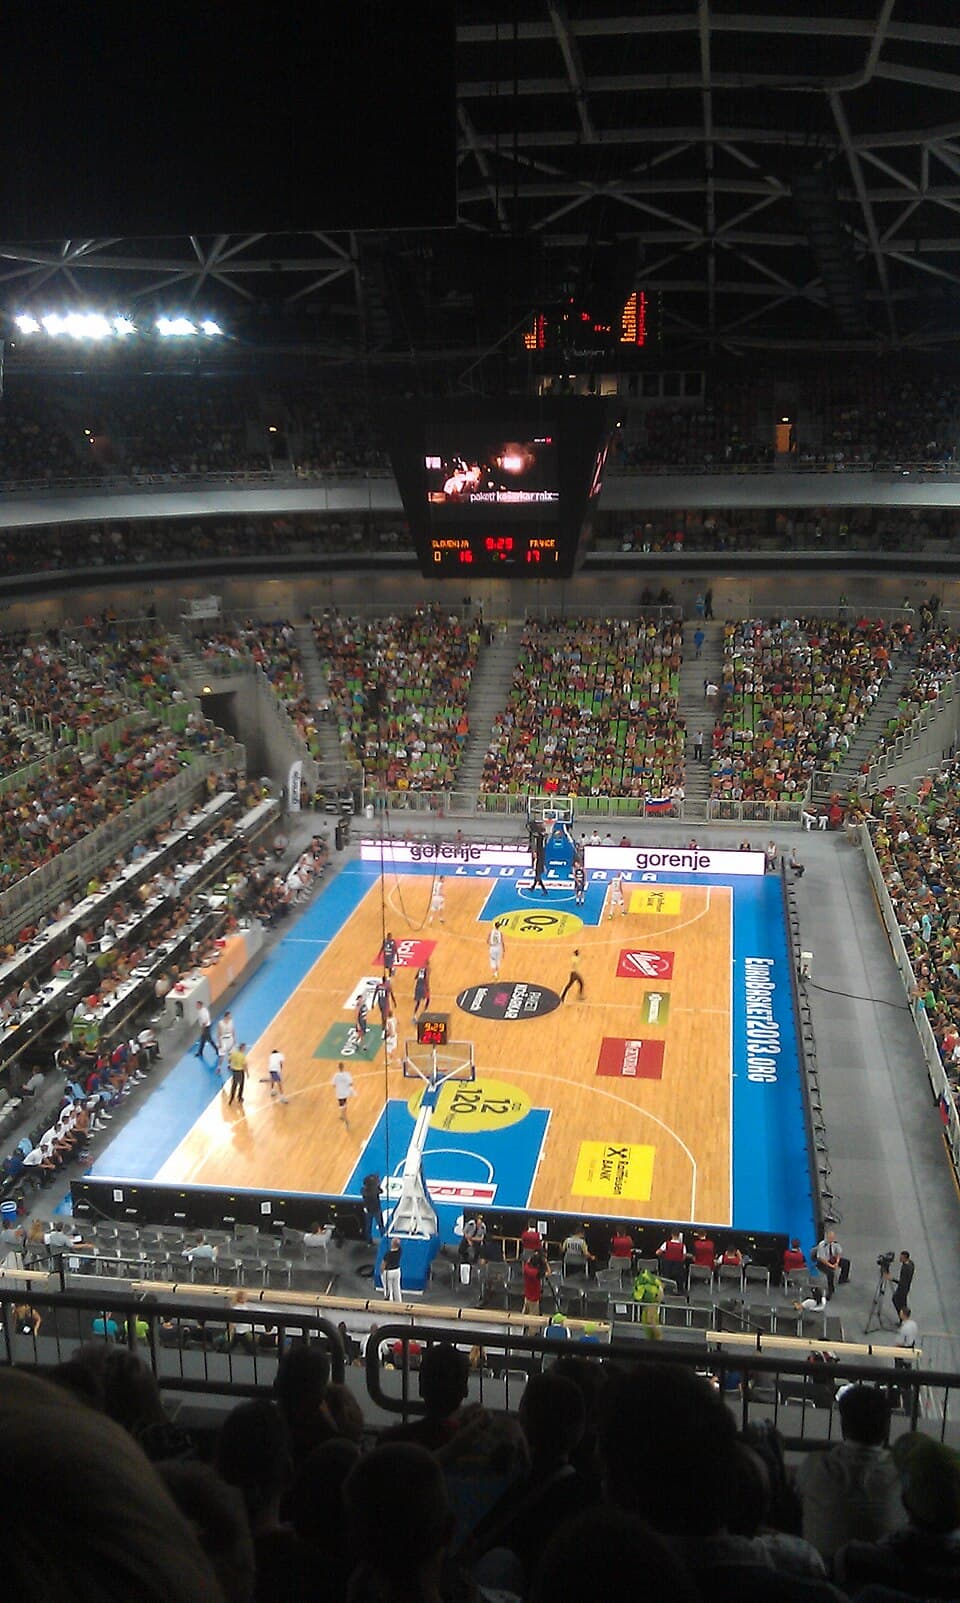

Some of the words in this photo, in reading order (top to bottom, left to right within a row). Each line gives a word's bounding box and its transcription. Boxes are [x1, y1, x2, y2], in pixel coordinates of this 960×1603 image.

[410, 845, 481, 862] gorenje
[636, 851, 711, 870] gorenje
[450, 1088, 483, 1114] 120
[480, 1098, 511, 1114] 12
